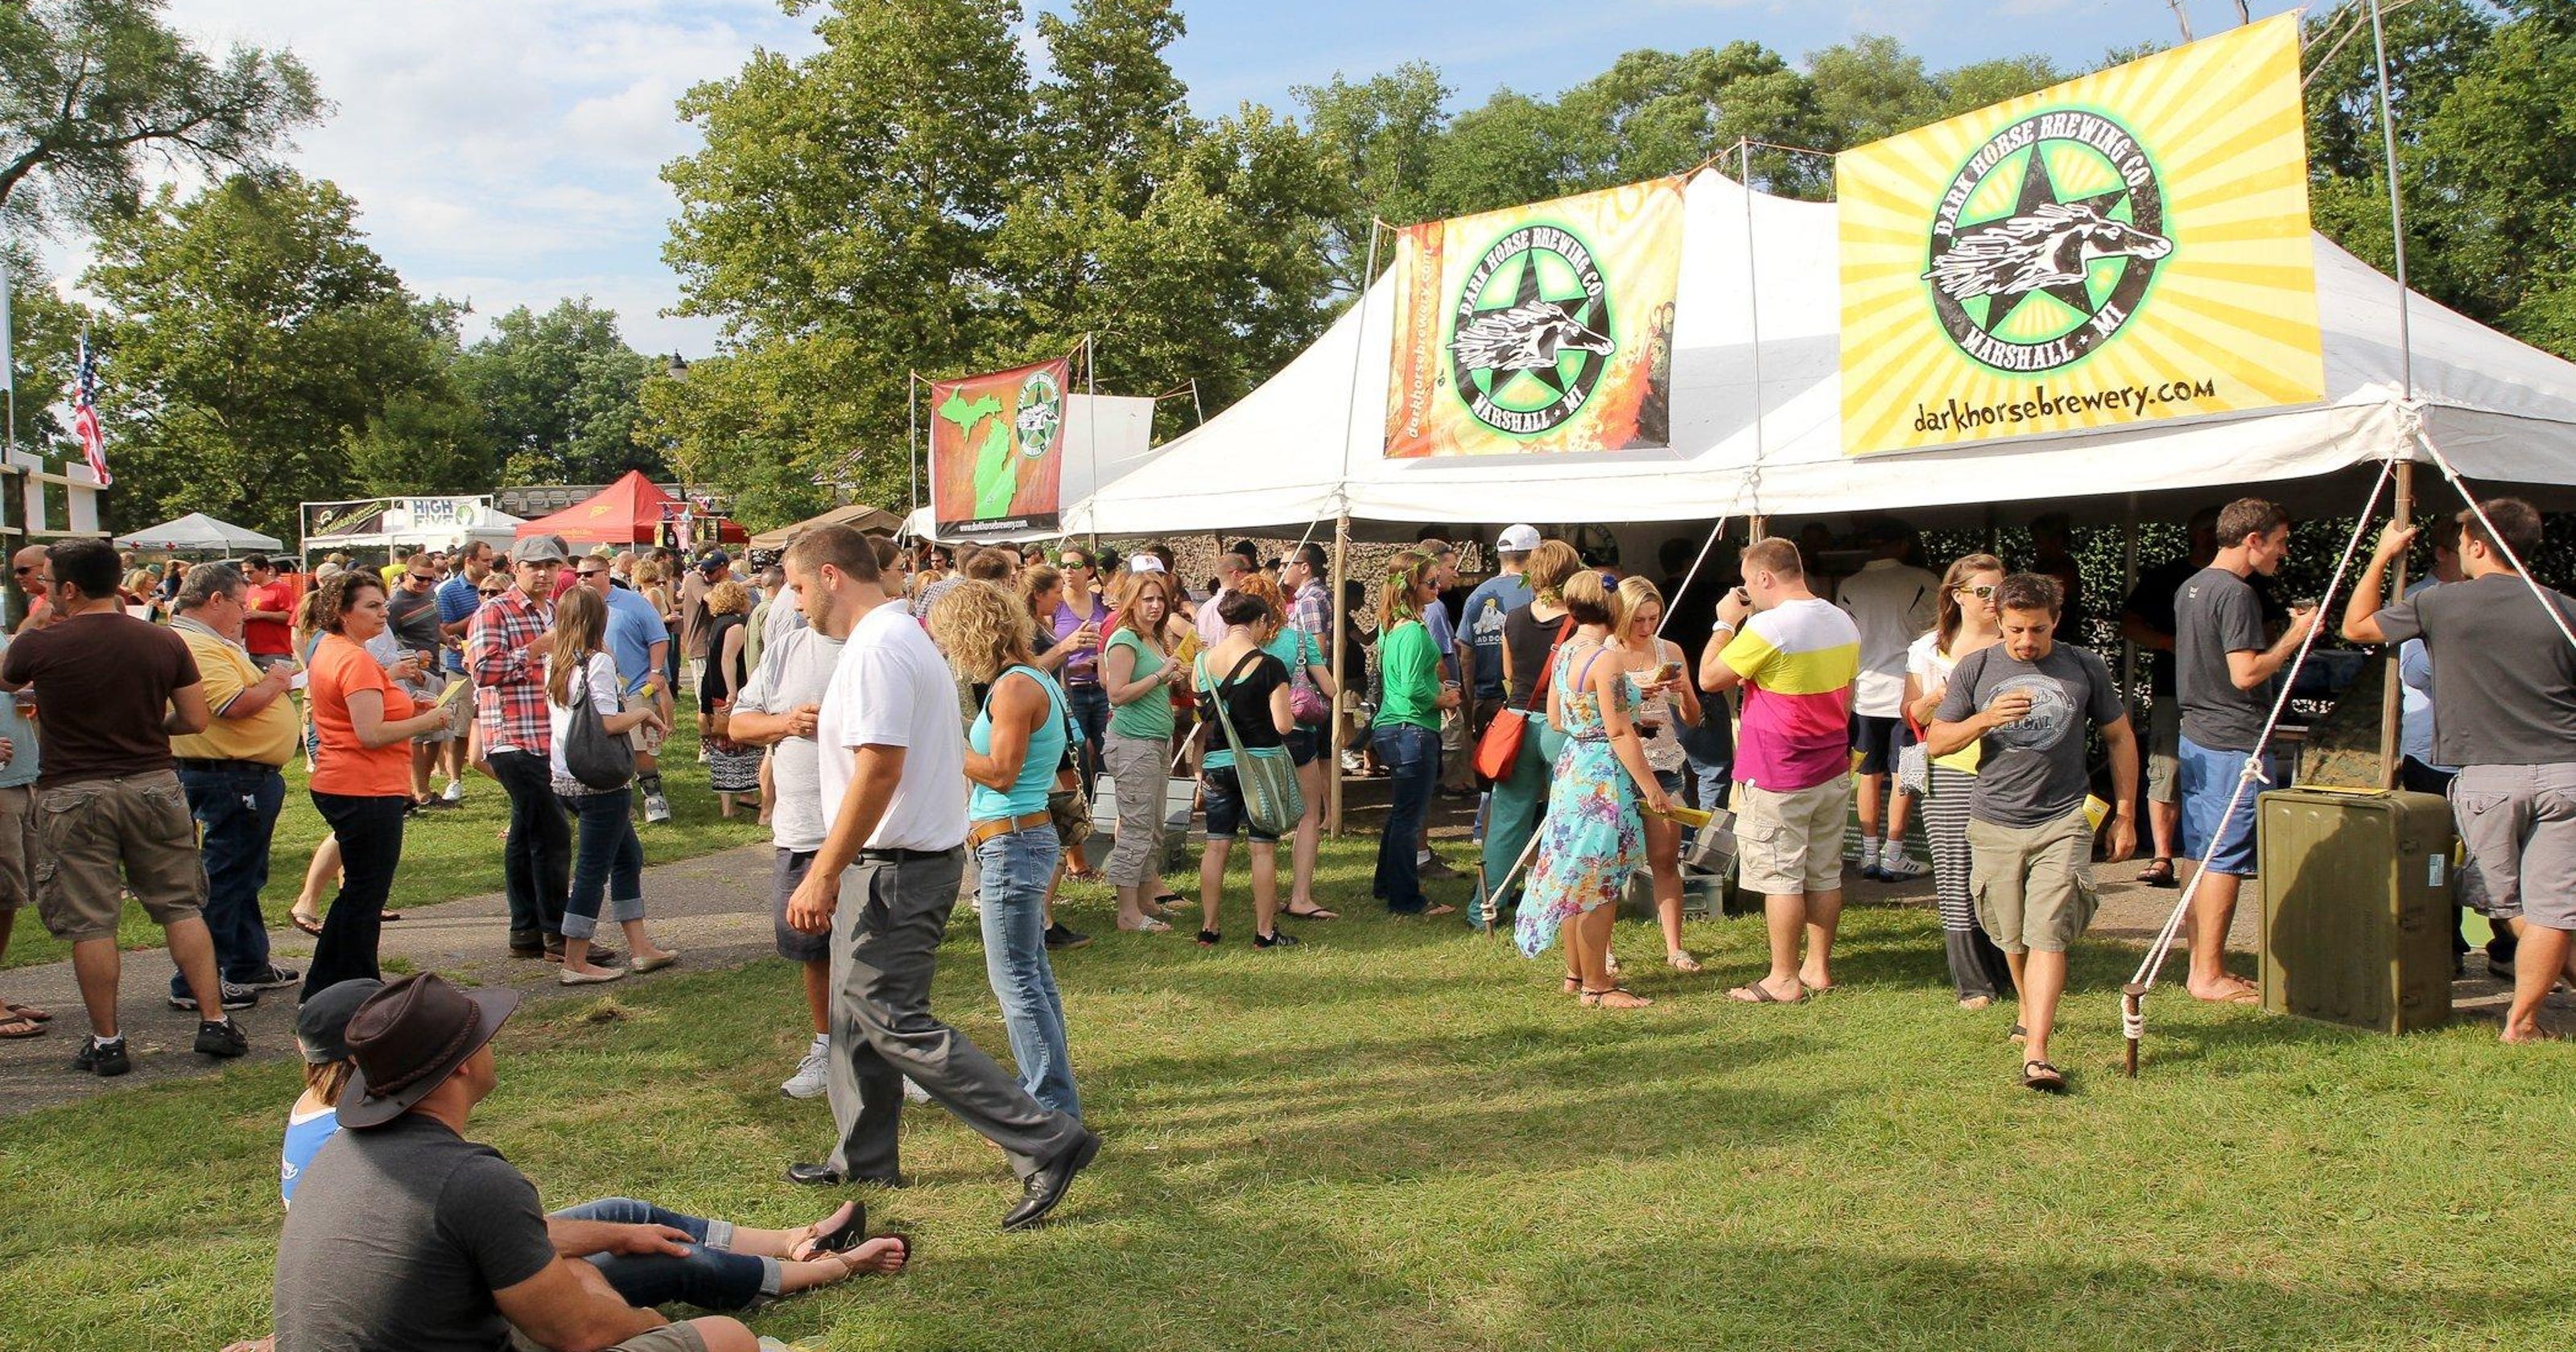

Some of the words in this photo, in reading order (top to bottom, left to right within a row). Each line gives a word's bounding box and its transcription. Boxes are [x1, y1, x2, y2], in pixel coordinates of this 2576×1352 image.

[1934, 172, 1977, 237] DARK
[1968, 121, 2034, 178] HORSE
[2038, 113, 2133, 160] BREWING
[2121, 155, 2152, 195] CO.
[1459, 265, 1490, 318] DARK
[1484, 229, 1530, 273] HORSE
[1531, 227, 1591, 275] BREWING
[1406, 248, 1434, 439] darkhorsebrewery.com
[1960, 326, 2075, 371] MARSHALL
[2089, 300, 2128, 340] MI
[1471, 391, 1551, 432] MARSHALL
[1562, 384, 1587, 415] MI
